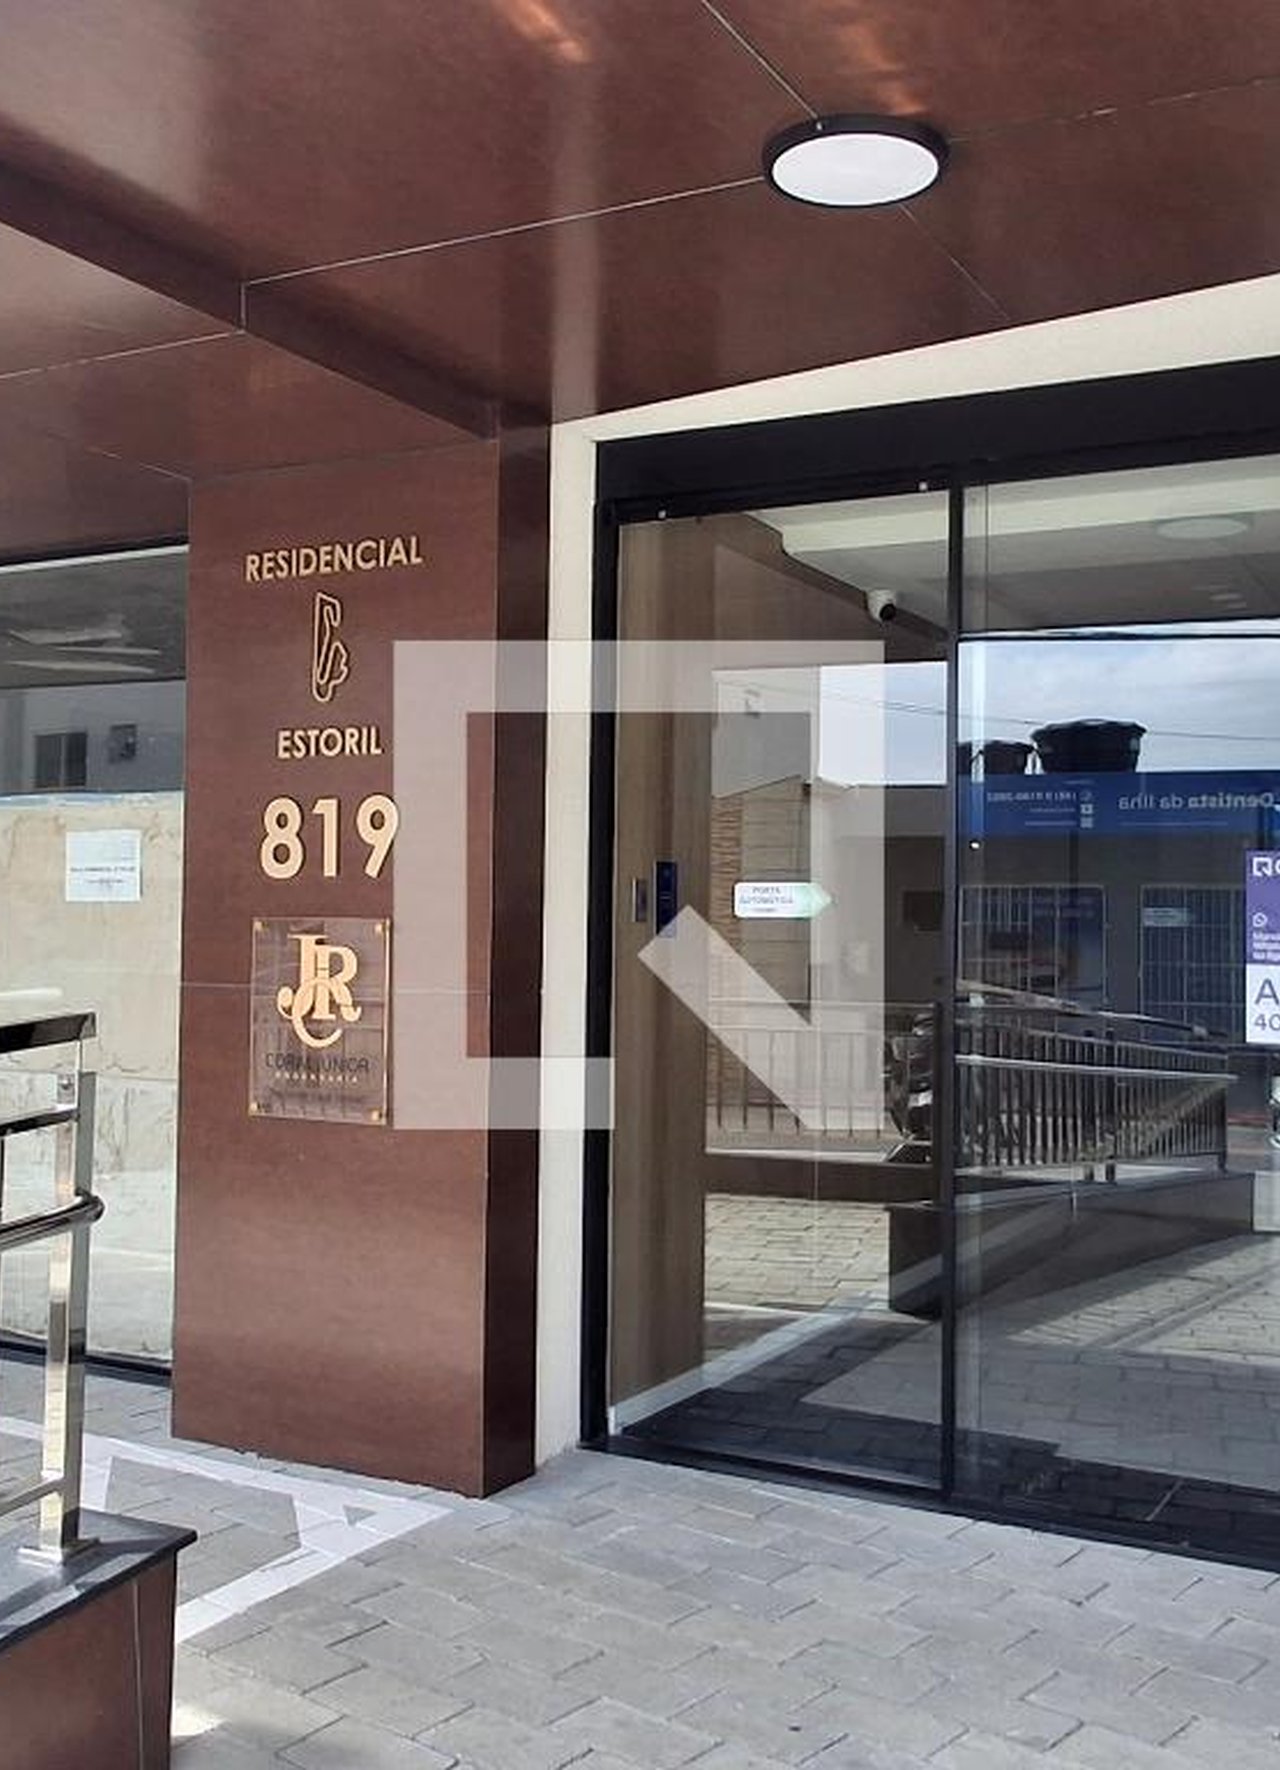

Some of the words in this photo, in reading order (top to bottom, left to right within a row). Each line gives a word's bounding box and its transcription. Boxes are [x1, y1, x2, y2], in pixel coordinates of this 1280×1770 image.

[245, 536, 423, 582] RESIDENCIAL
[278, 726, 383, 759] ESTORIL
[260, 794, 399, 880] 819
